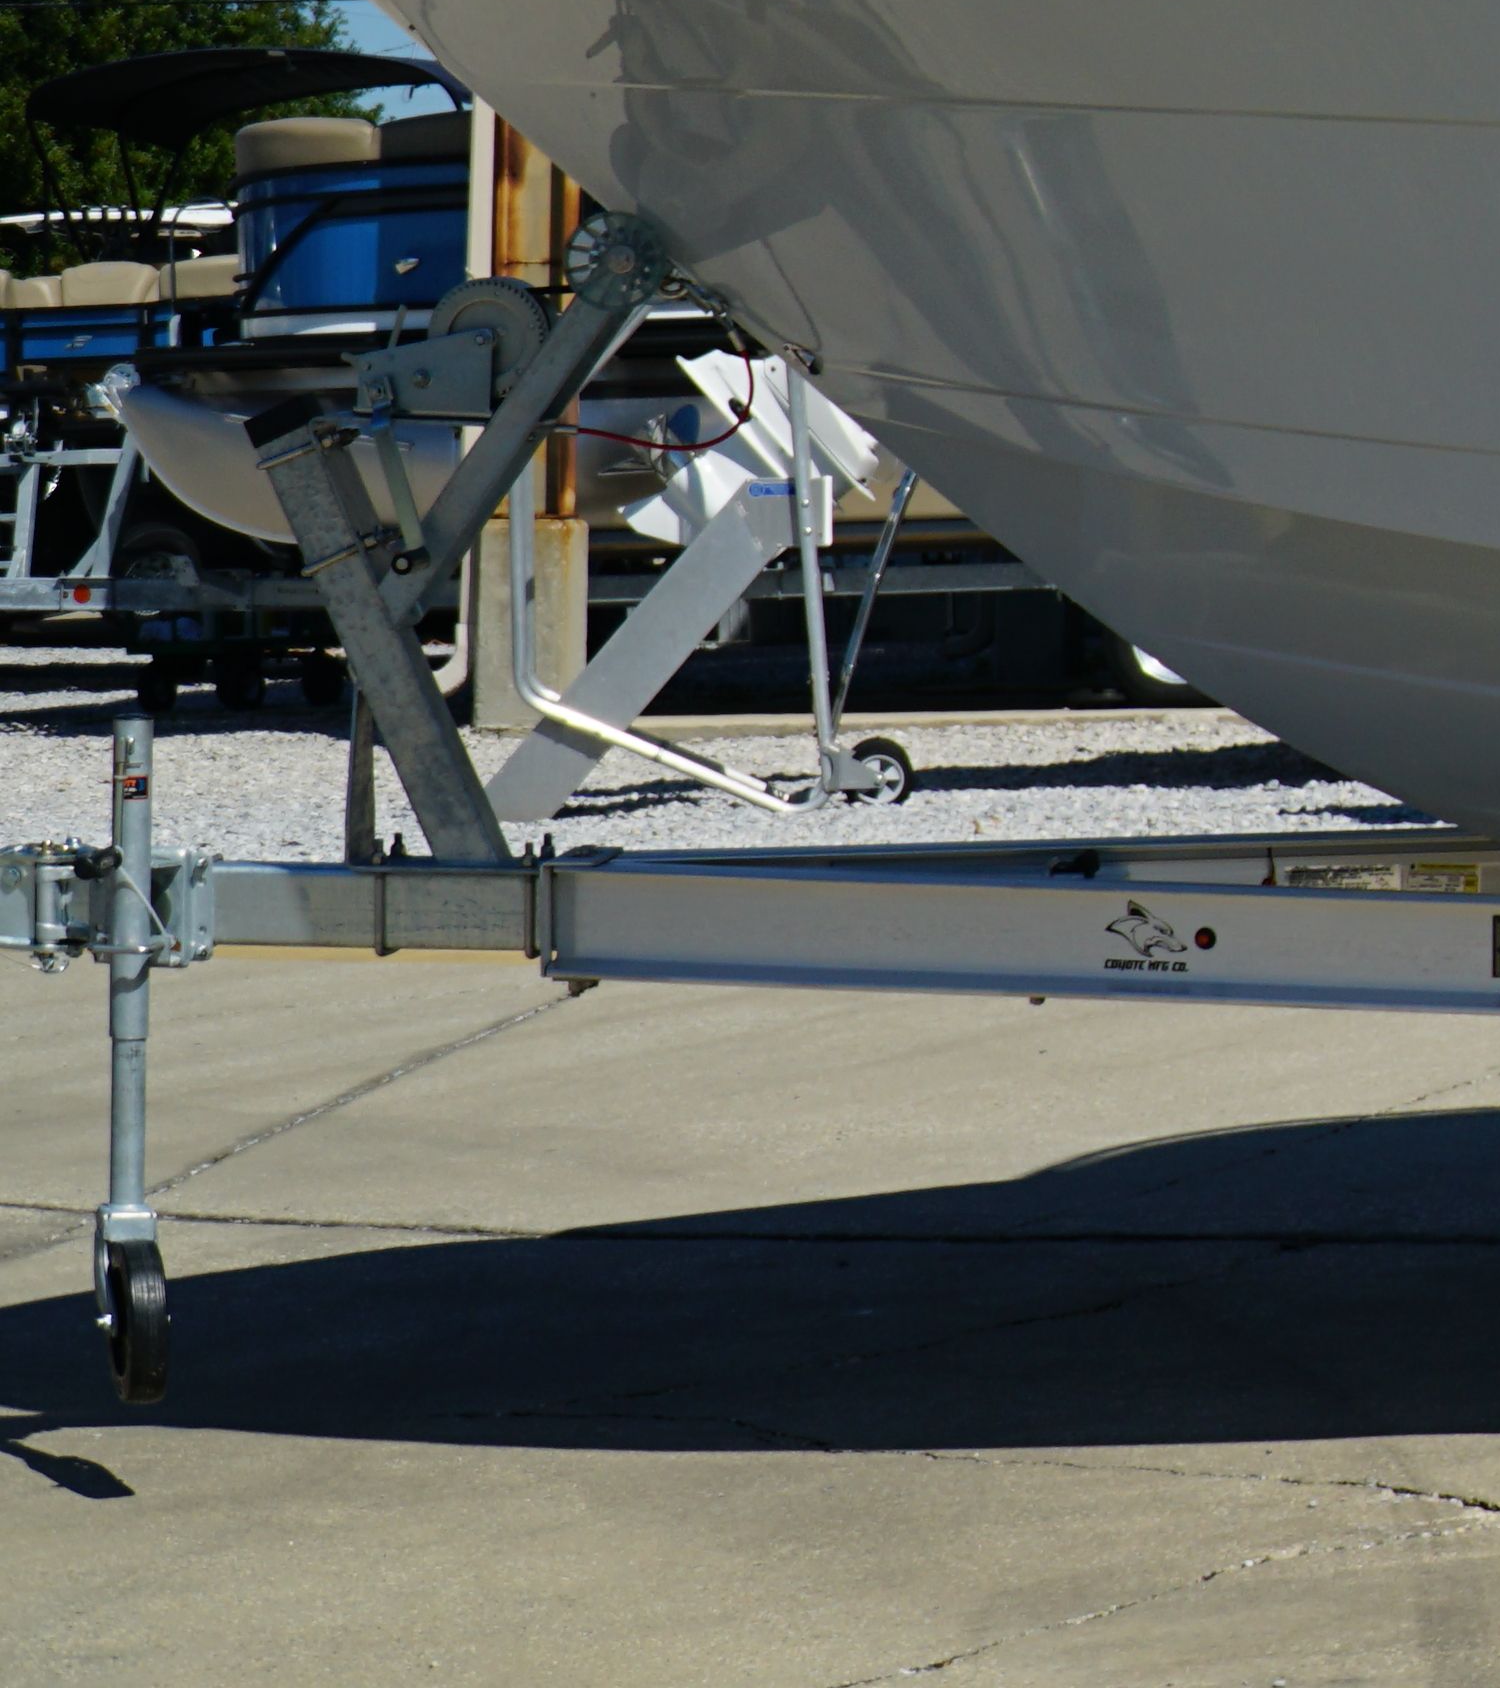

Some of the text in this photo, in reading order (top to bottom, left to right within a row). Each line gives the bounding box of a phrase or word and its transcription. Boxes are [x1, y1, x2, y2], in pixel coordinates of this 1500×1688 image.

[1103, 958, 1189, 973] COYOTE MFG CO.
